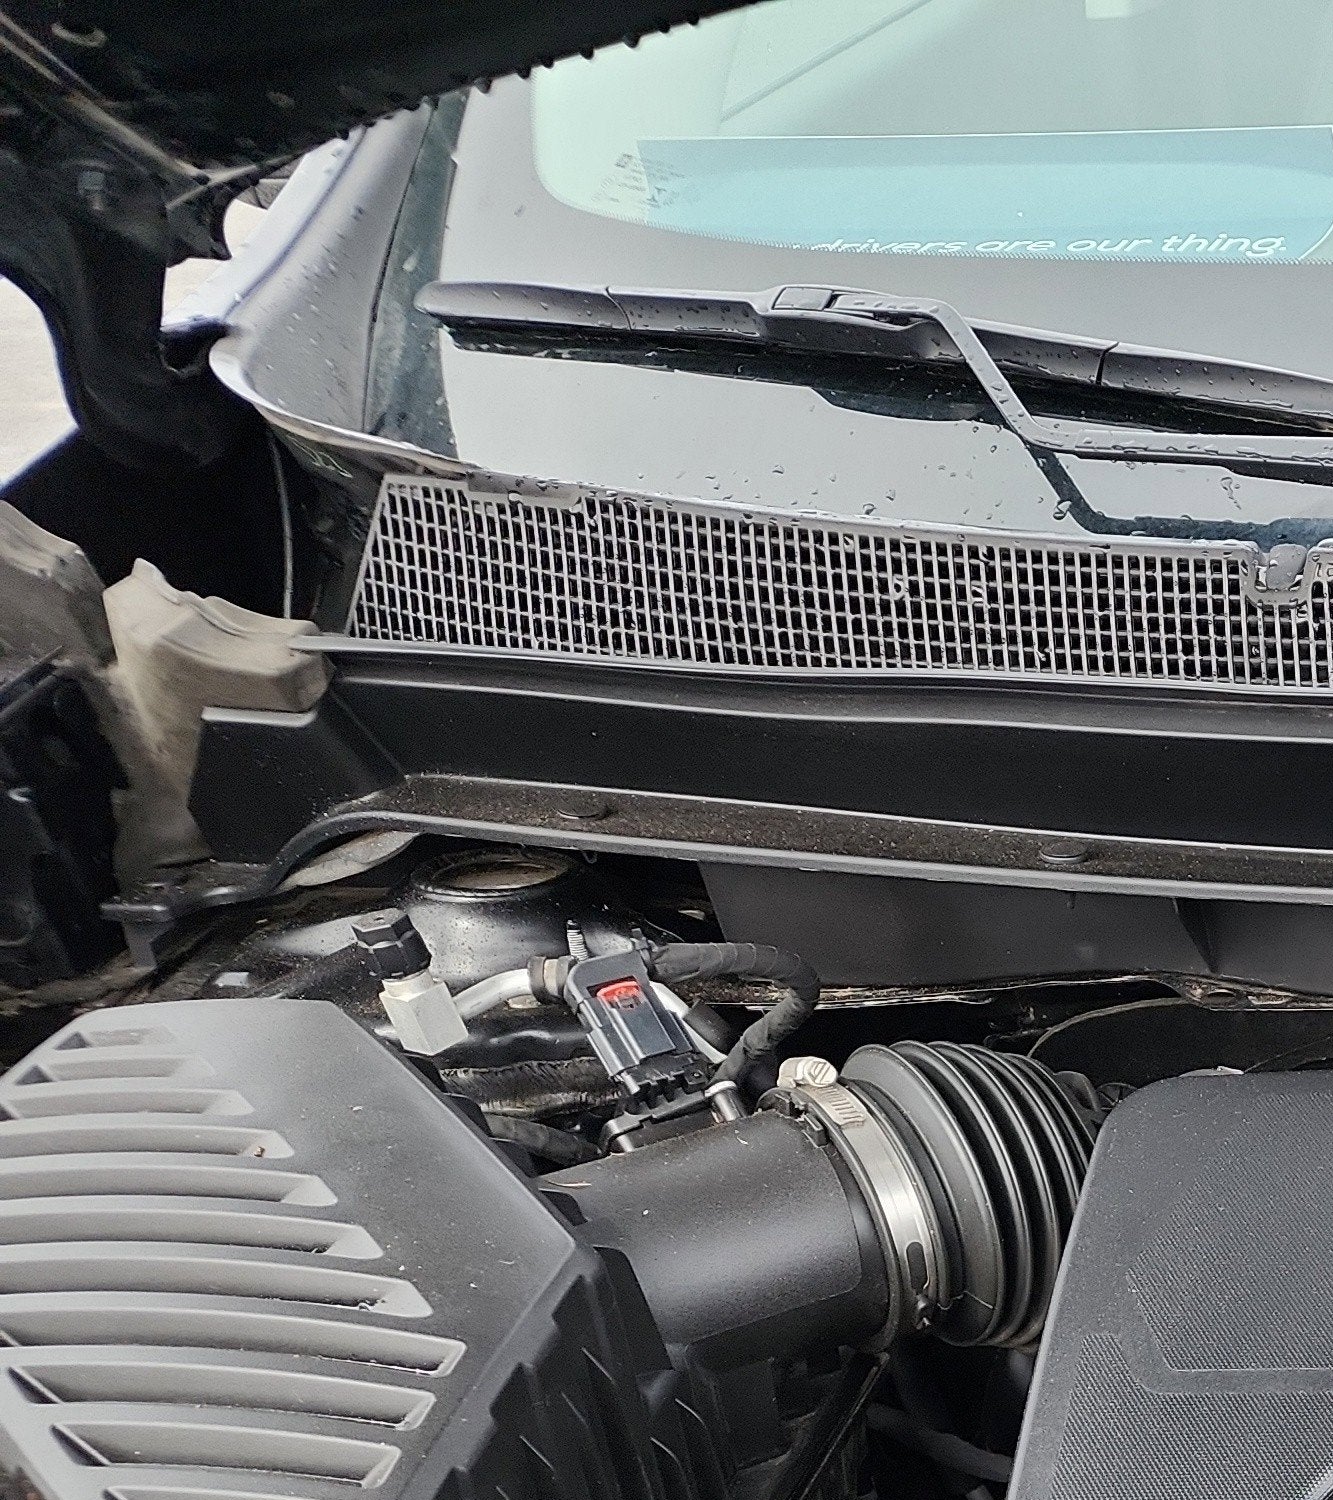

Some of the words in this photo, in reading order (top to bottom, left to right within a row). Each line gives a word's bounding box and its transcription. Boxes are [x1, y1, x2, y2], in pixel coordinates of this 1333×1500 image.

[975, 238, 1057, 252] are
[1066, 238, 1155, 252] our
[1161, 233, 1287, 257] thing.
